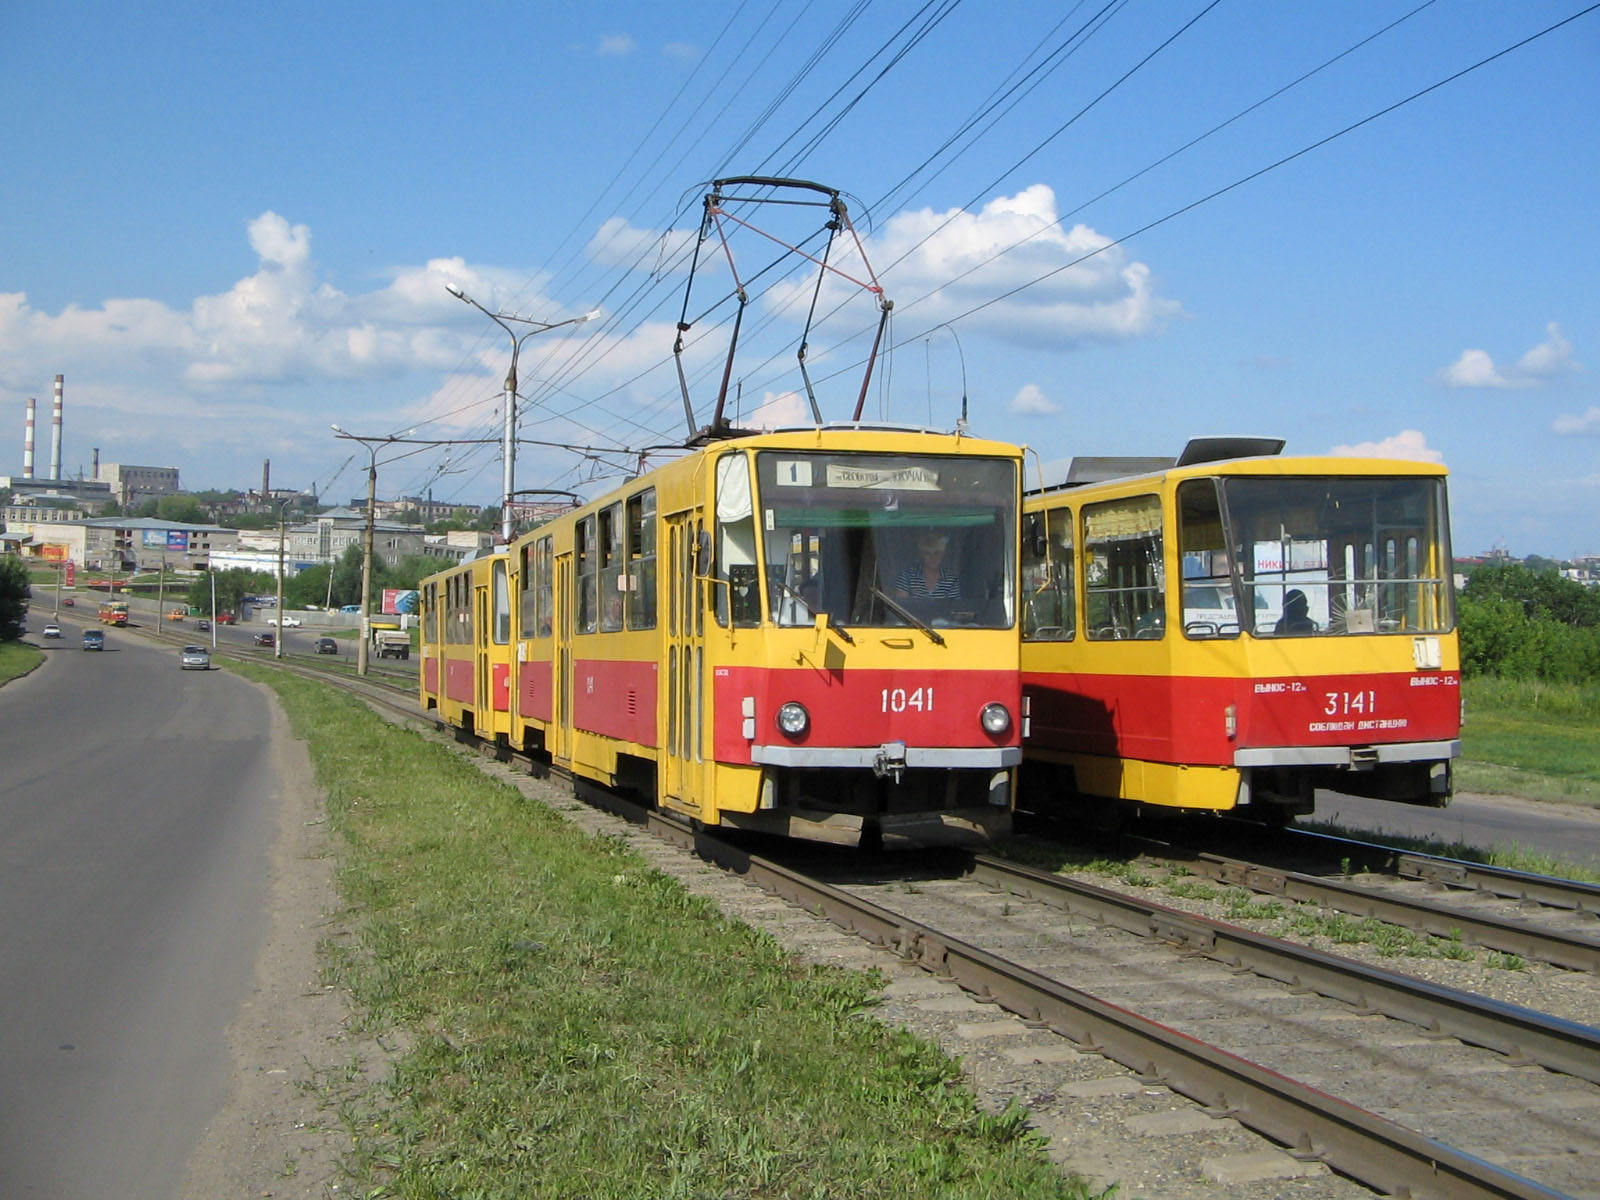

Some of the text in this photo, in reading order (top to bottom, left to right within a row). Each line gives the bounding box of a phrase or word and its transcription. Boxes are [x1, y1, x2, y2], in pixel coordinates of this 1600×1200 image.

[789, 462, 797, 482] 1
[880, 687, 933, 713] 1041
[1324, 690, 1376, 715] 3141
